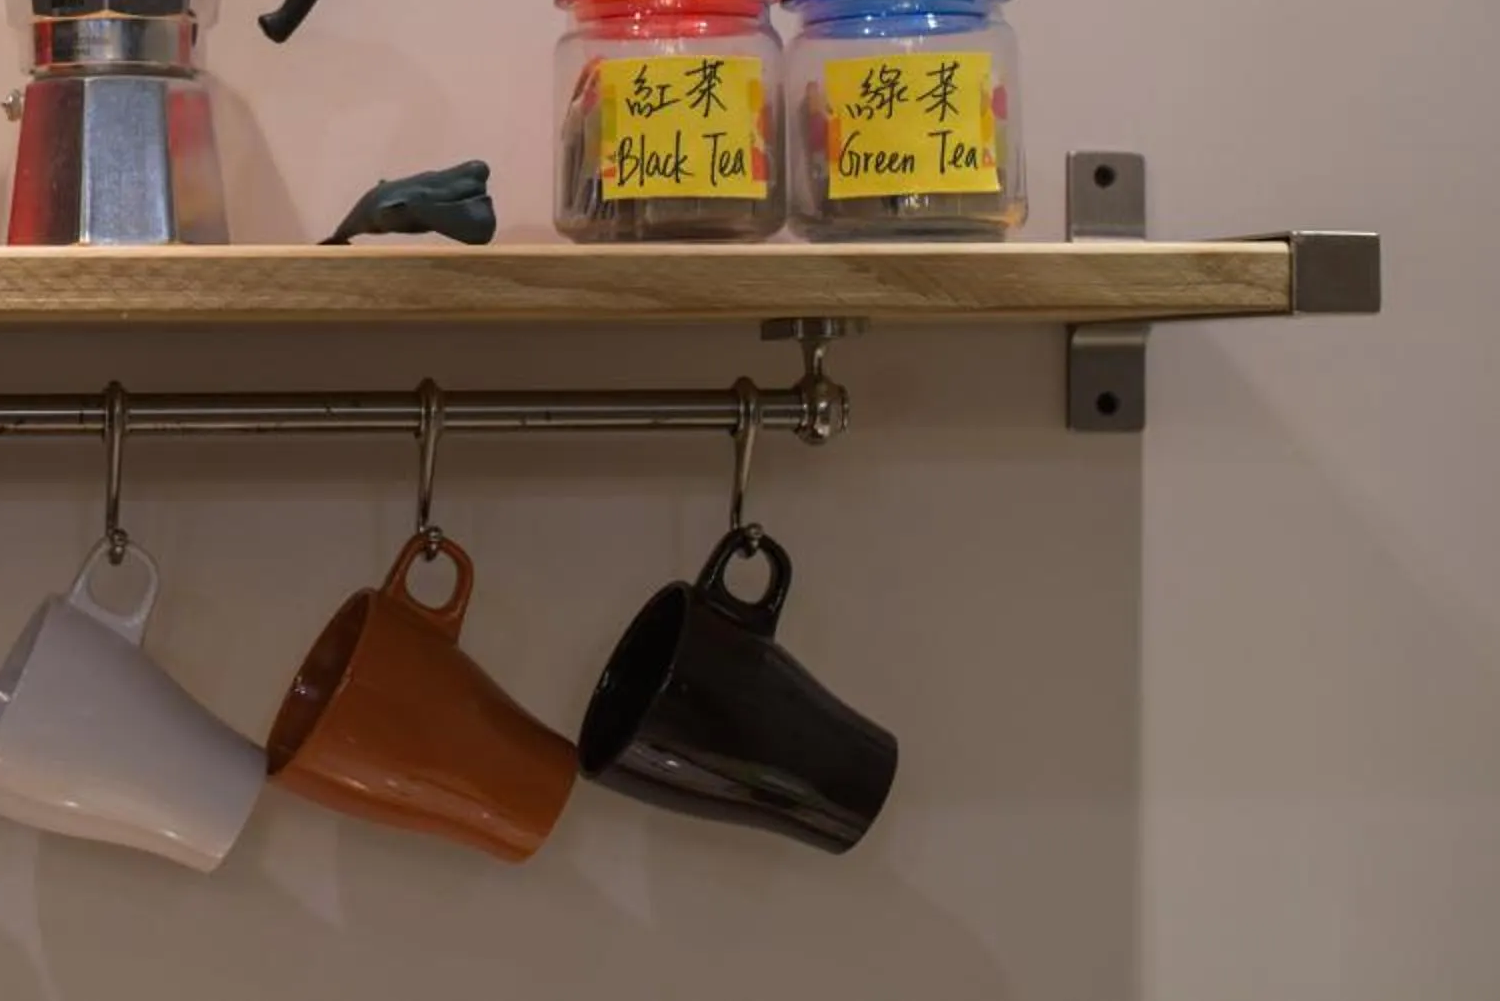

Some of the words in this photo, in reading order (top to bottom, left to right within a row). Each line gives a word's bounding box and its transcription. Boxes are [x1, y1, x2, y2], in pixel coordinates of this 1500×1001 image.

[625, 58, 728, 118] 紅茶
[617, 130, 695, 187] Black
[701, 132, 747, 186] Tea
[838, 130, 916, 178] Green
[927, 129, 979, 174] Tea
